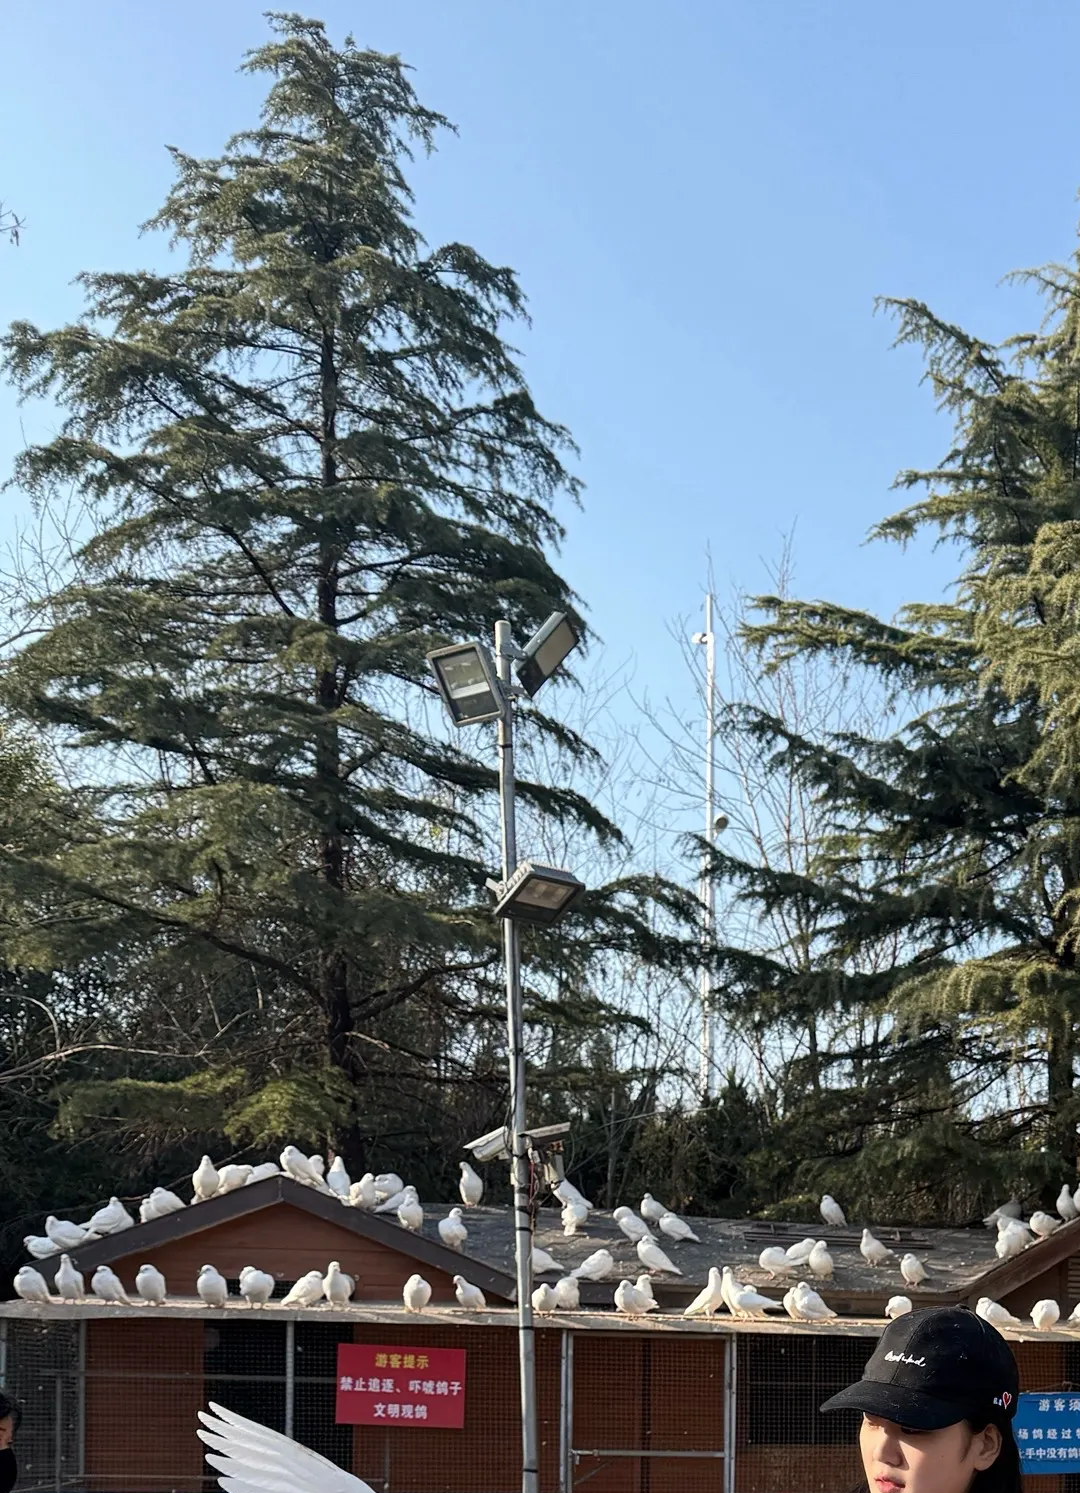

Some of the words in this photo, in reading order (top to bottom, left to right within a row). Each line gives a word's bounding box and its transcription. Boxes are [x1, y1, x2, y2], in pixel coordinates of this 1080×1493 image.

[375, 1353, 429, 1369] 游客提示
[373, 1403, 428, 1419] 文明观鸽
